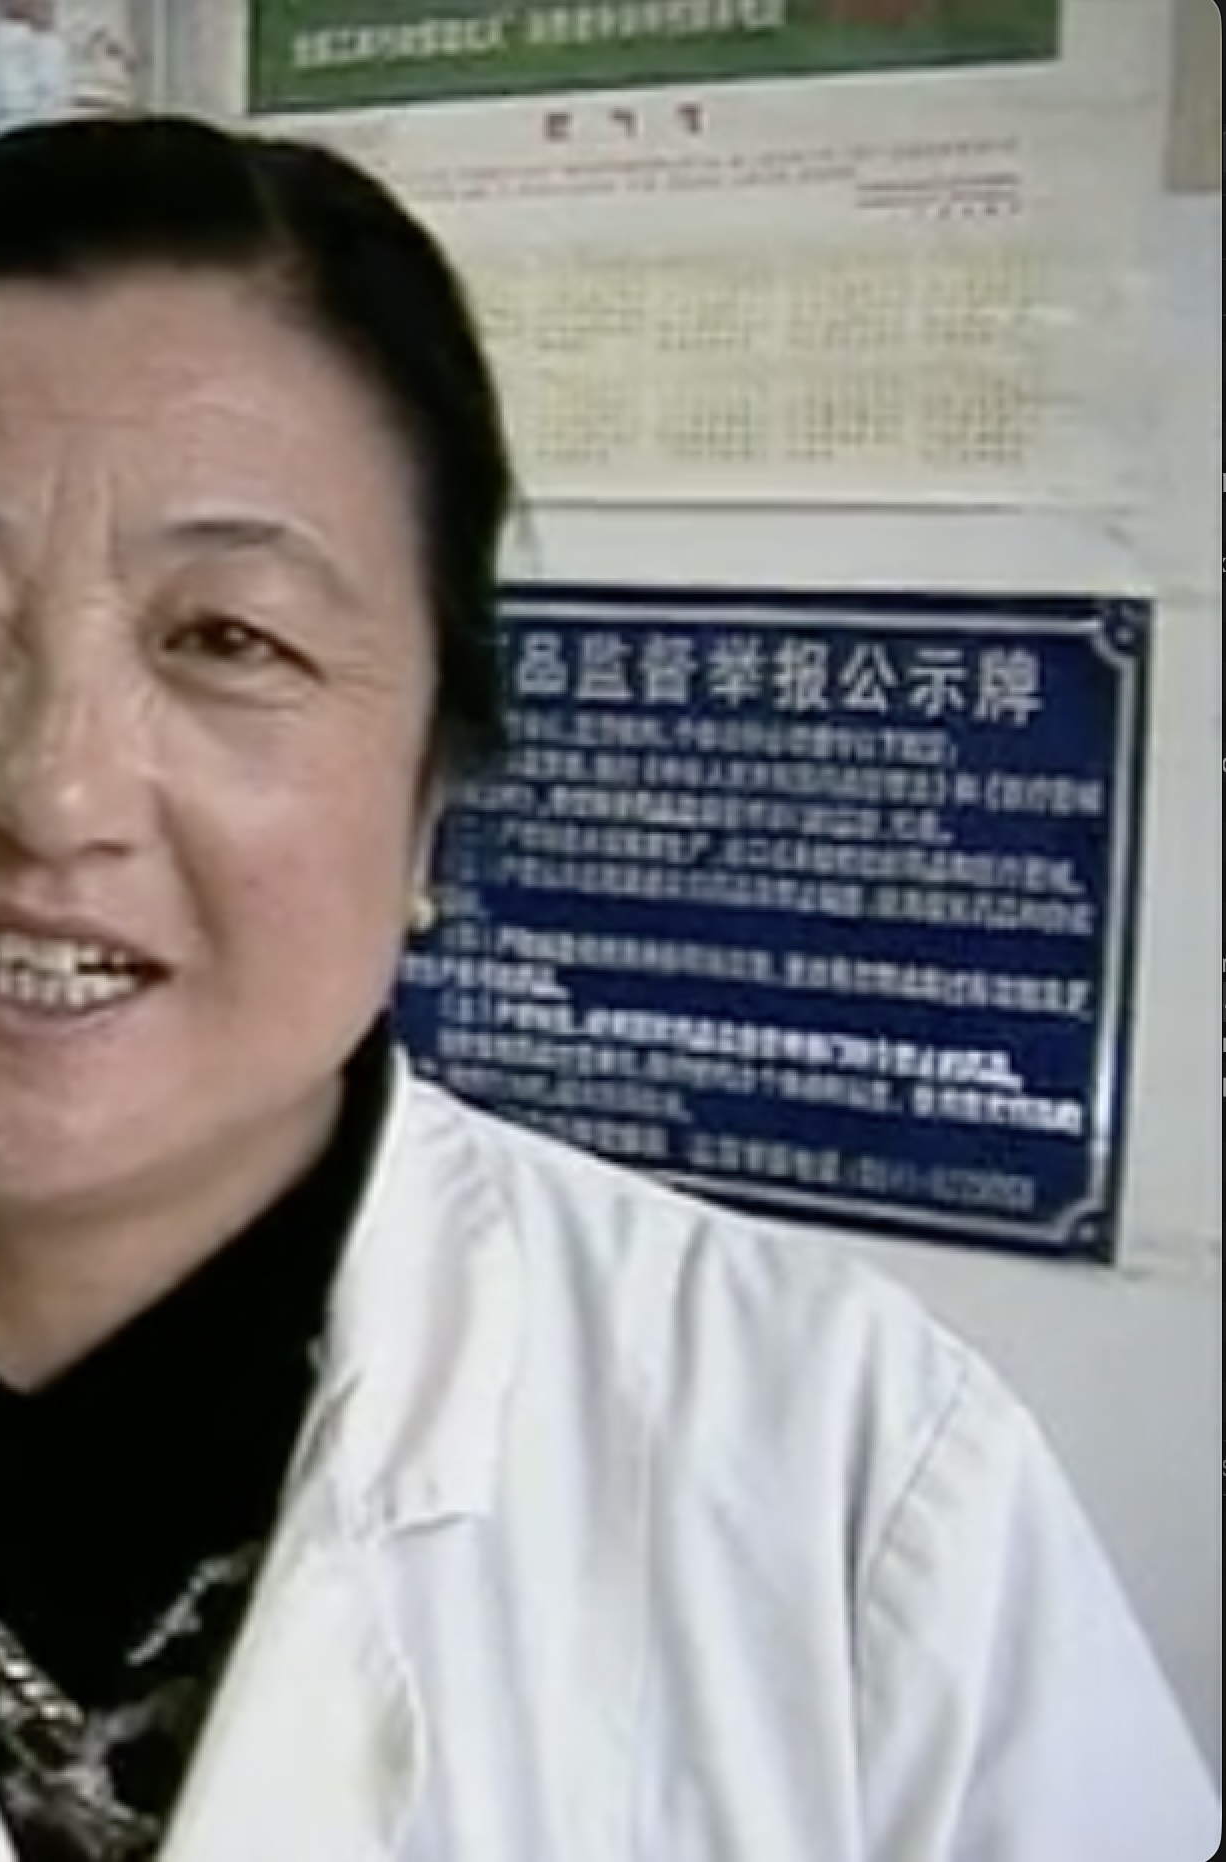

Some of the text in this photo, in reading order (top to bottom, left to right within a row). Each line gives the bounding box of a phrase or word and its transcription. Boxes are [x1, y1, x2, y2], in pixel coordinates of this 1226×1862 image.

[501, 631, 1044, 726] 品监督举报公示牌
